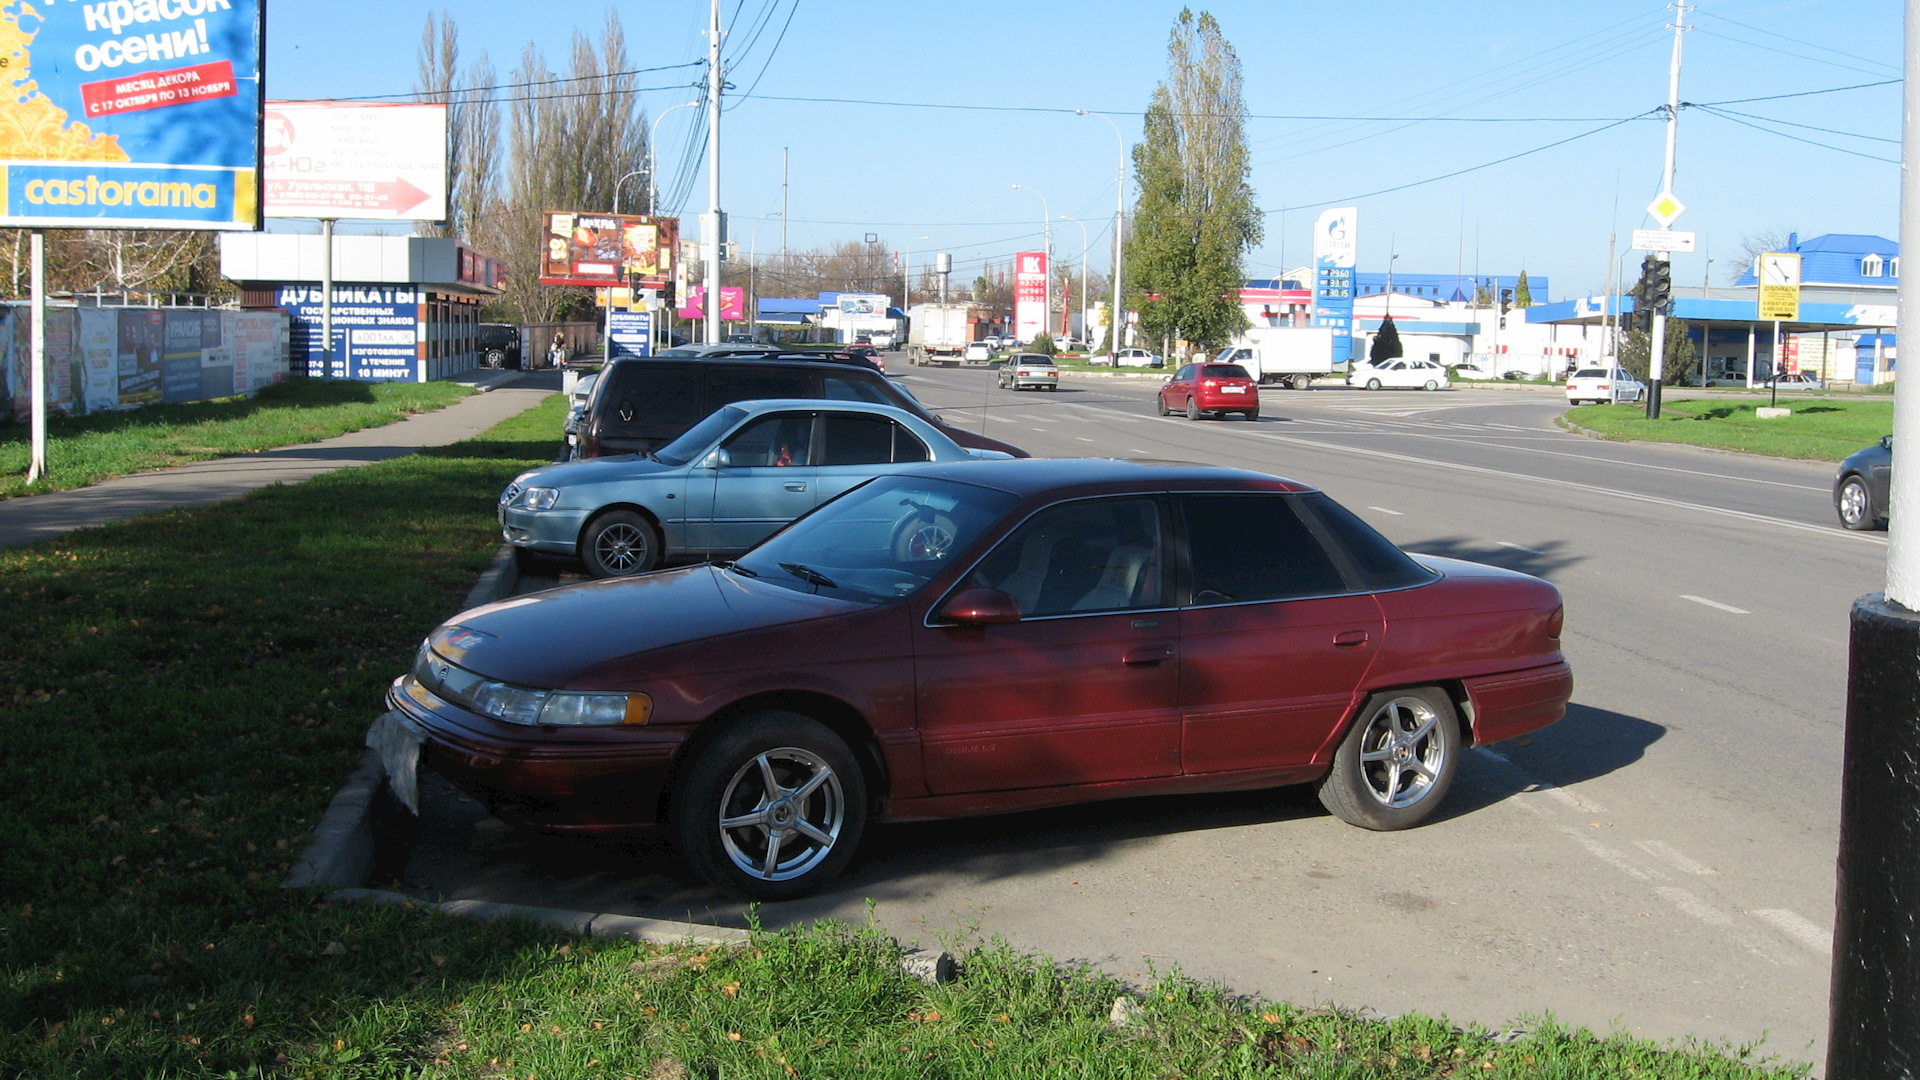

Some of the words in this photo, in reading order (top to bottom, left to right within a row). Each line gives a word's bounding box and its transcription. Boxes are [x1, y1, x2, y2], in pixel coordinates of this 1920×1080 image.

[75, 18, 210, 72] осени!
[115, 76, 157, 95] МЕСЯЦ
[157, 71, 201, 89] ДЕКОРА
[90, 102, 100, 113] С
[101, 99, 114, 111] 17
[115, 93, 158, 110] ОКТЯБРЯ
[159, 90, 176, 102] ПО
[177, 87, 190, 98] 13
[191, 81, 231, 96] НОЯБРЯ
[25, 175, 216, 208] castorama
[266, 183, 284, 192] ул.
[300, 306, 395, 316] ГОСУАРСТВЕННЫХ
[377, 316, 415, 325] ЗНАКОВ
[352, 348, 415, 356] ИЗГОТОВЛЕНИЕ
[358, 369, 371, 378] 10
[372, 369, 411, 378] МИНУТ
